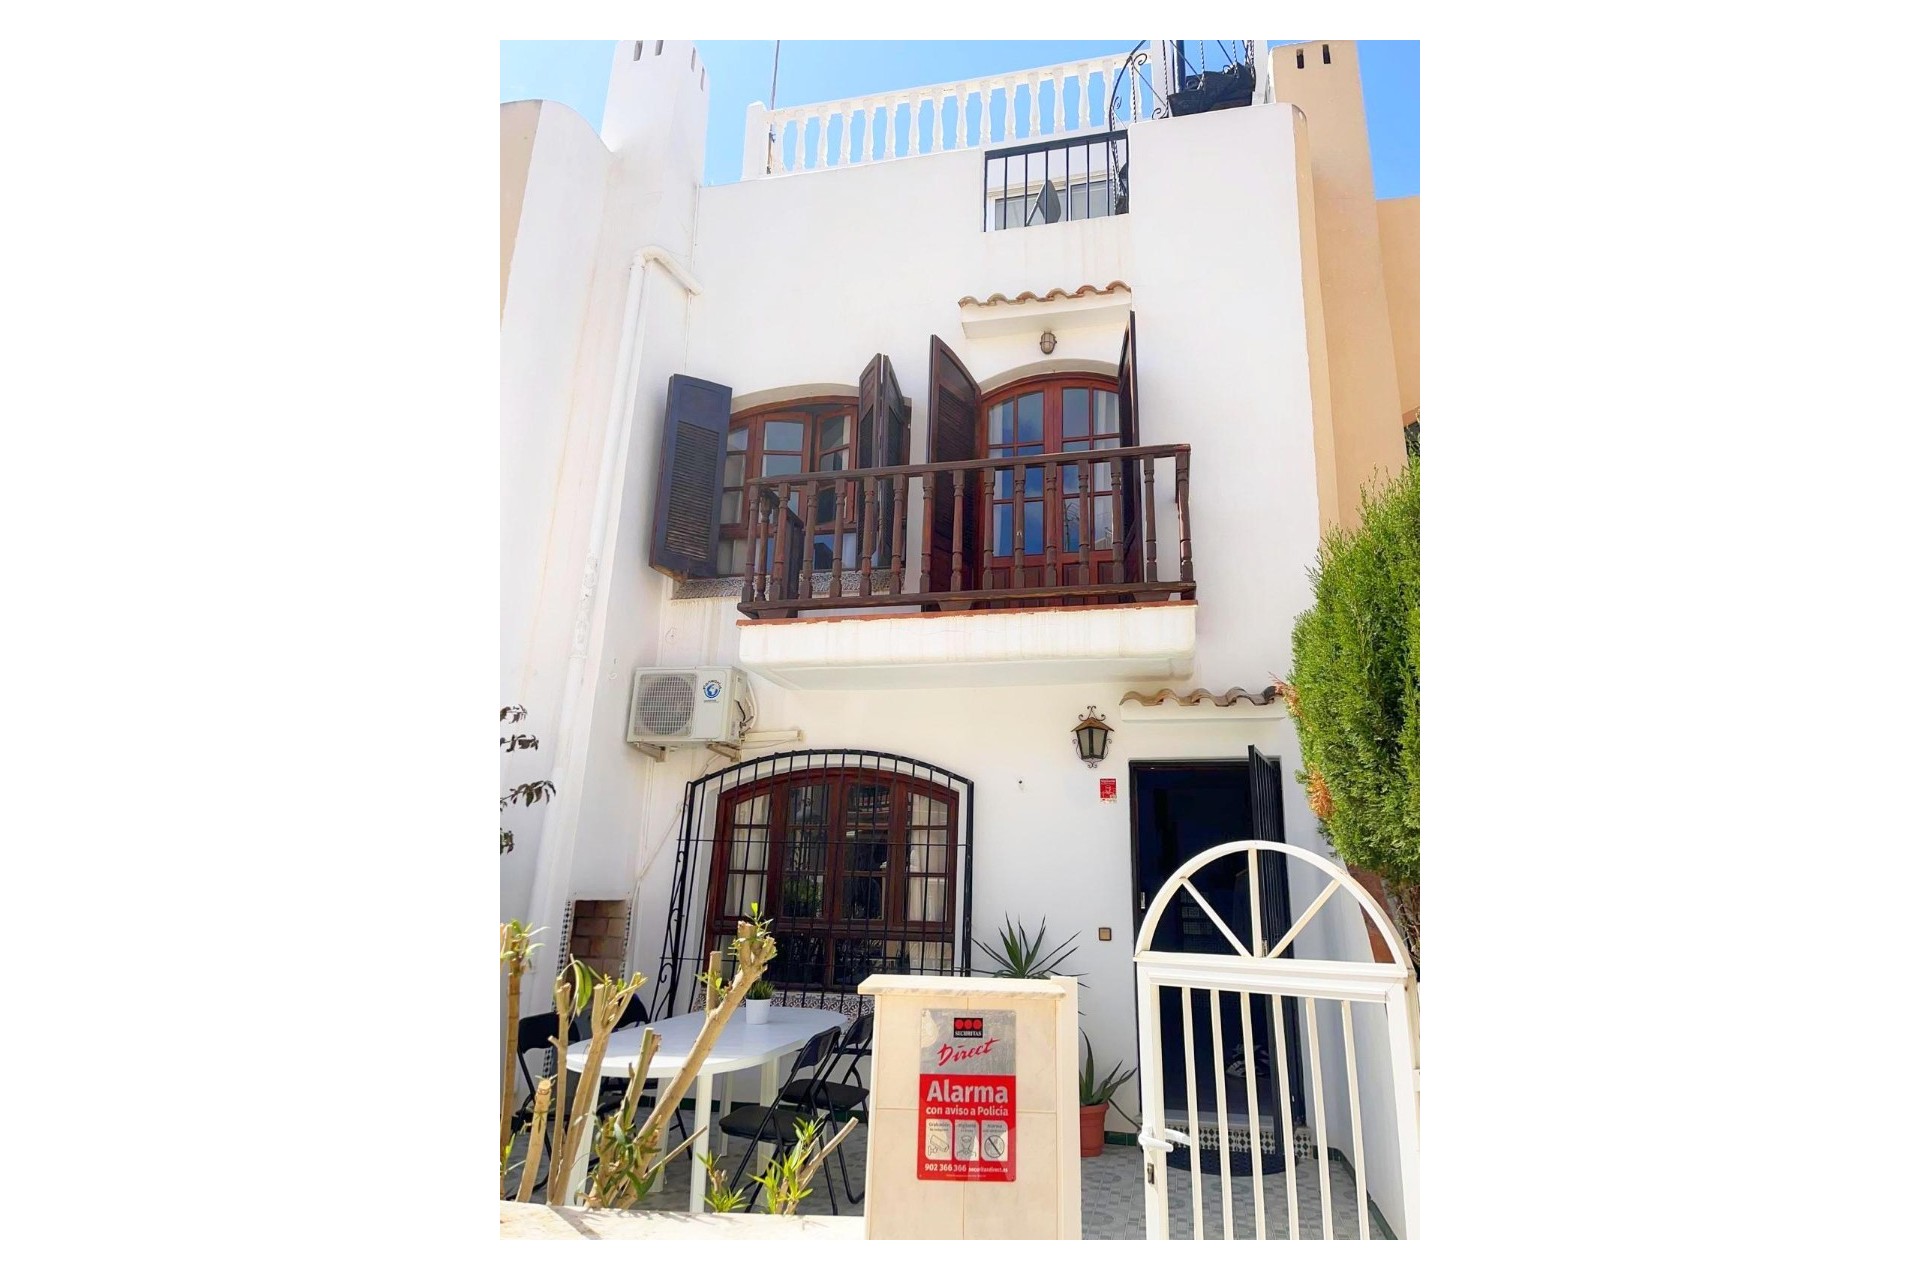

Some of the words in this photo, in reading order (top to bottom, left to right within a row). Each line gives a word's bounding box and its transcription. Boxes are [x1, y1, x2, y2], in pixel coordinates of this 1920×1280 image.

[937, 1037, 1000, 1067] Direct
[926, 1079, 1008, 1103] Alarma
[926, 1106, 942, 1115] con
[945, 1105, 968, 1115] aviso
[970, 1107, 976, 1115] a
[977, 1105, 1008, 1116] Policía
[924, 1163, 938, 1171] 902
[939, 1164, 953, 1172] 366
[953, 1164, 967, 1172] 366
